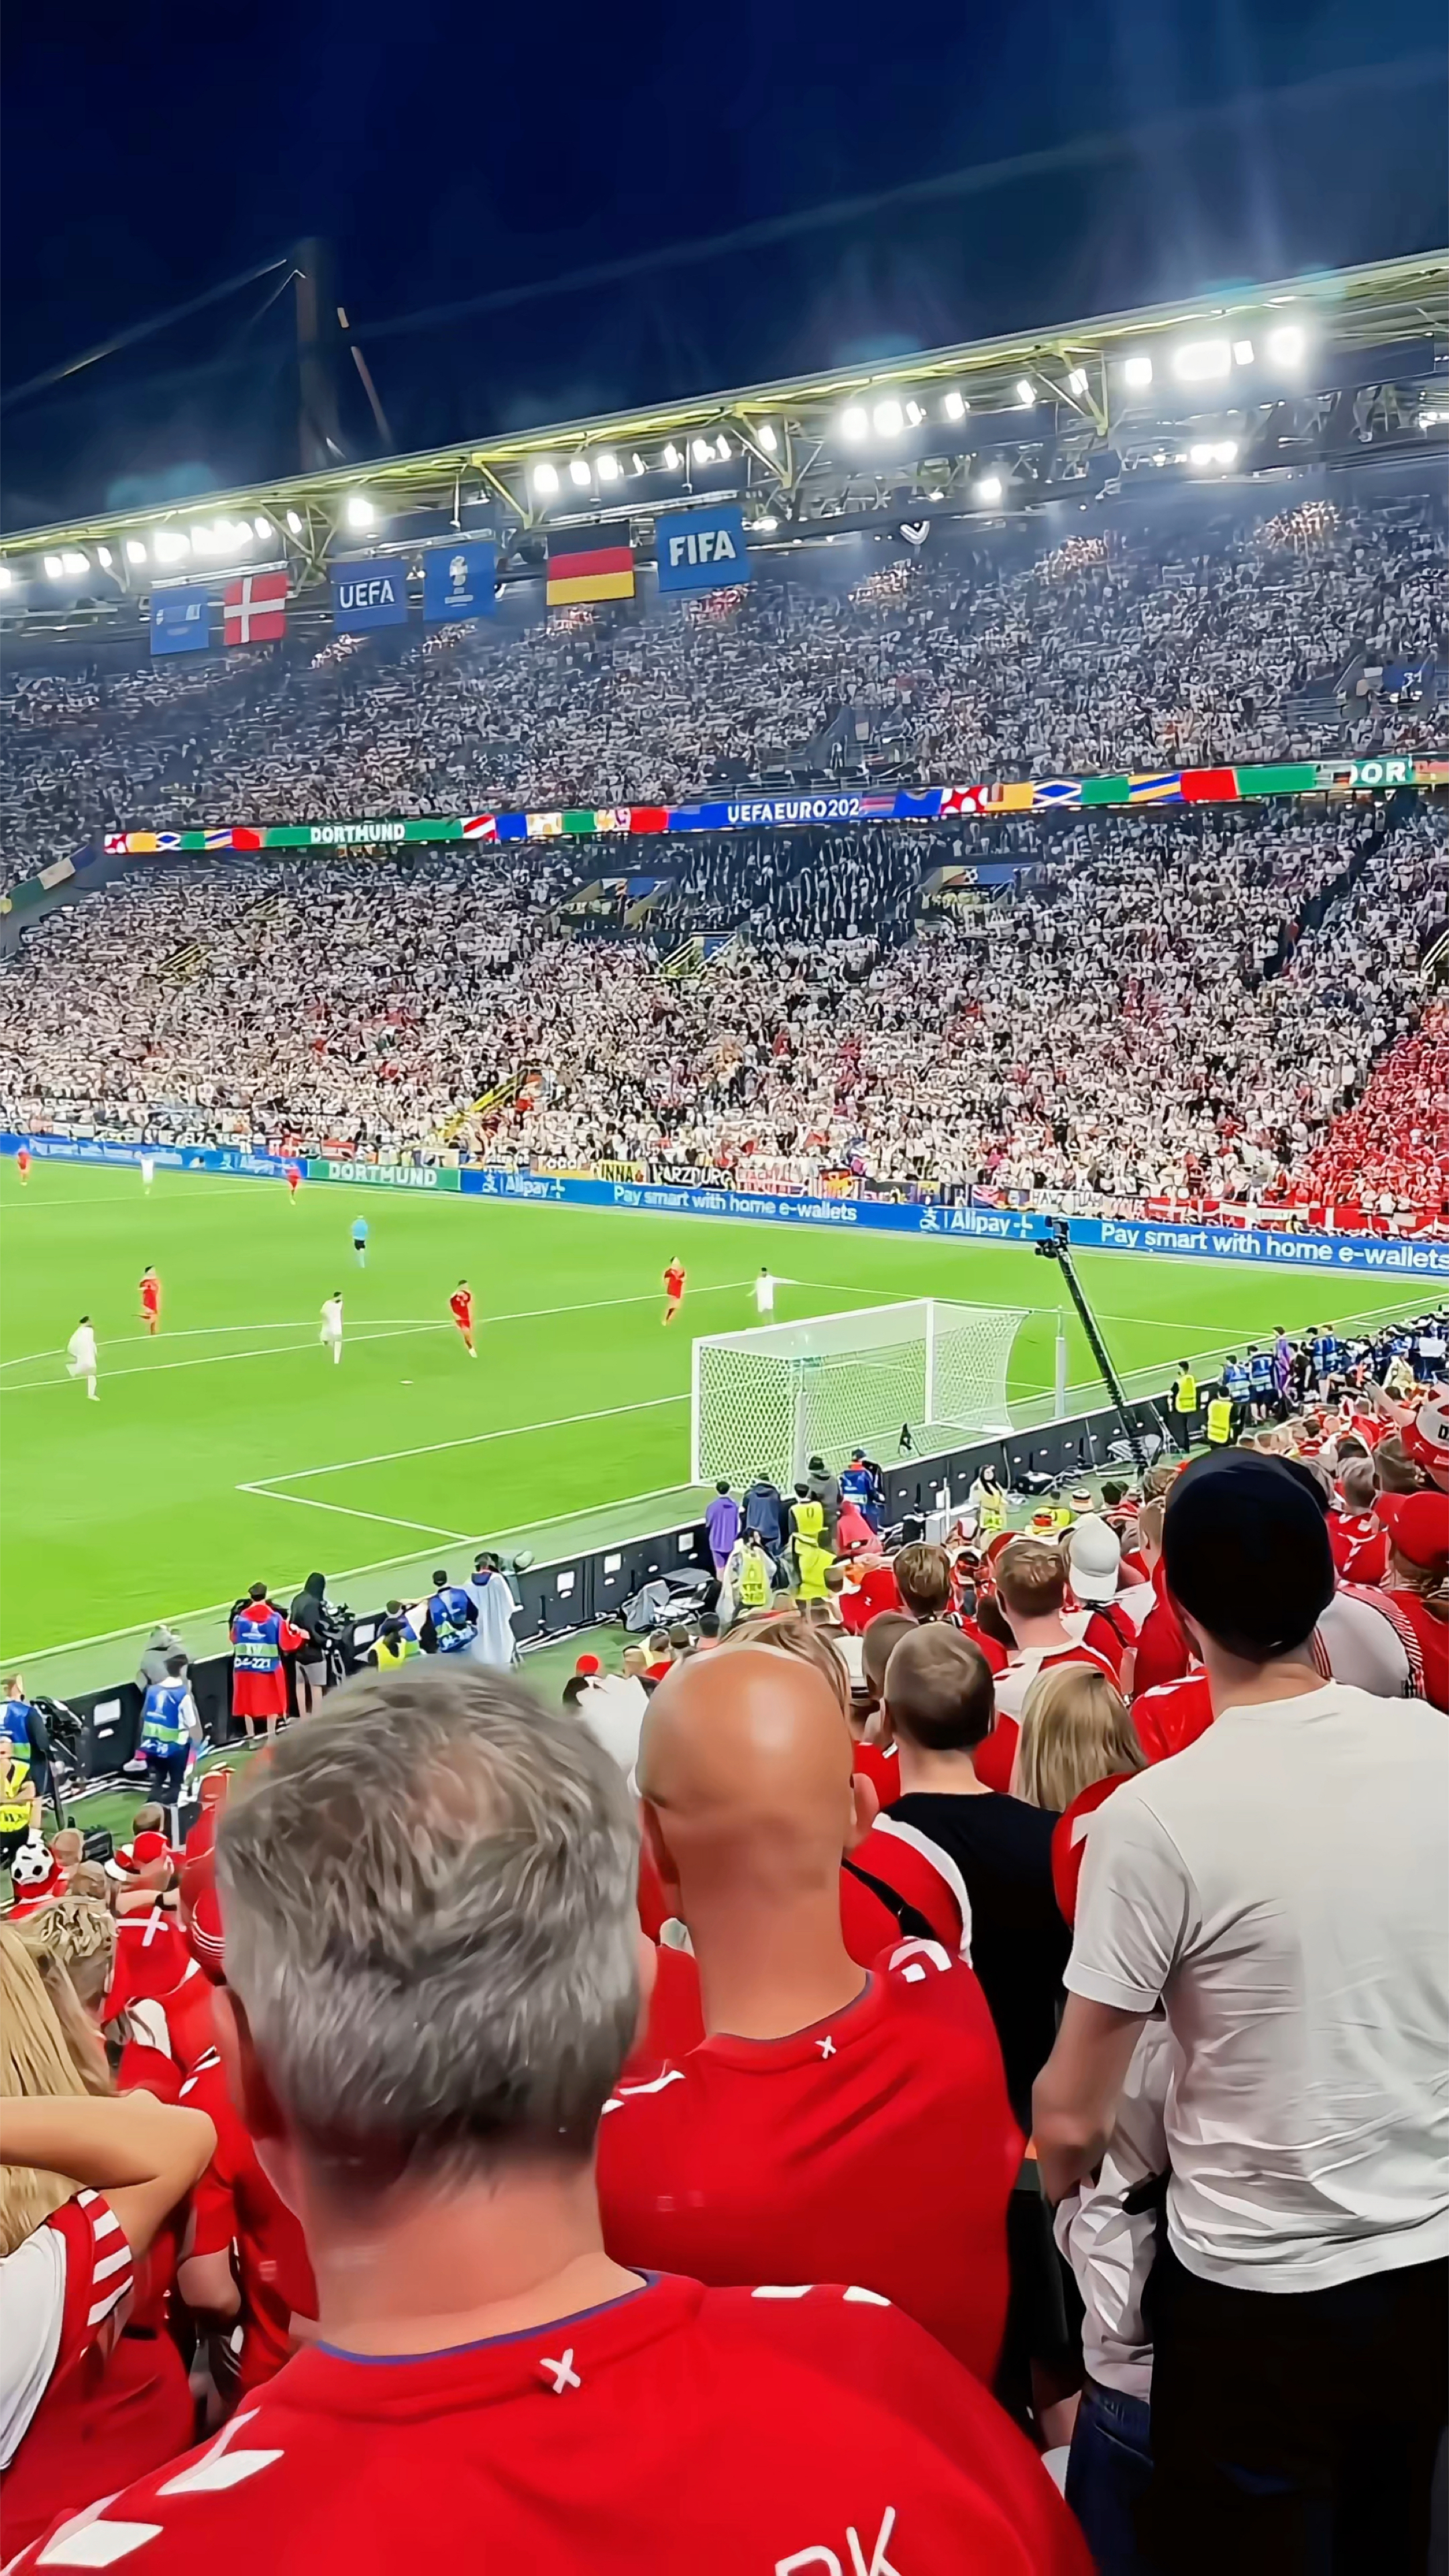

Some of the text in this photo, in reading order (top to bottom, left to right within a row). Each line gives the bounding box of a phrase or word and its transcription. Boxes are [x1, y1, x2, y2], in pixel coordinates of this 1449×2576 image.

[669, 530, 736, 566] FIFA
[339, 579, 394, 608] UEFA
[311, 824, 405, 844] DORTMUND
[329, 1161, 437, 1187] DORTMUND
[614, 1185, 857, 1222] Pay smart with home e-wallets
[1101, 1222, 1449, 1270] Pay smart with home e-wallets
